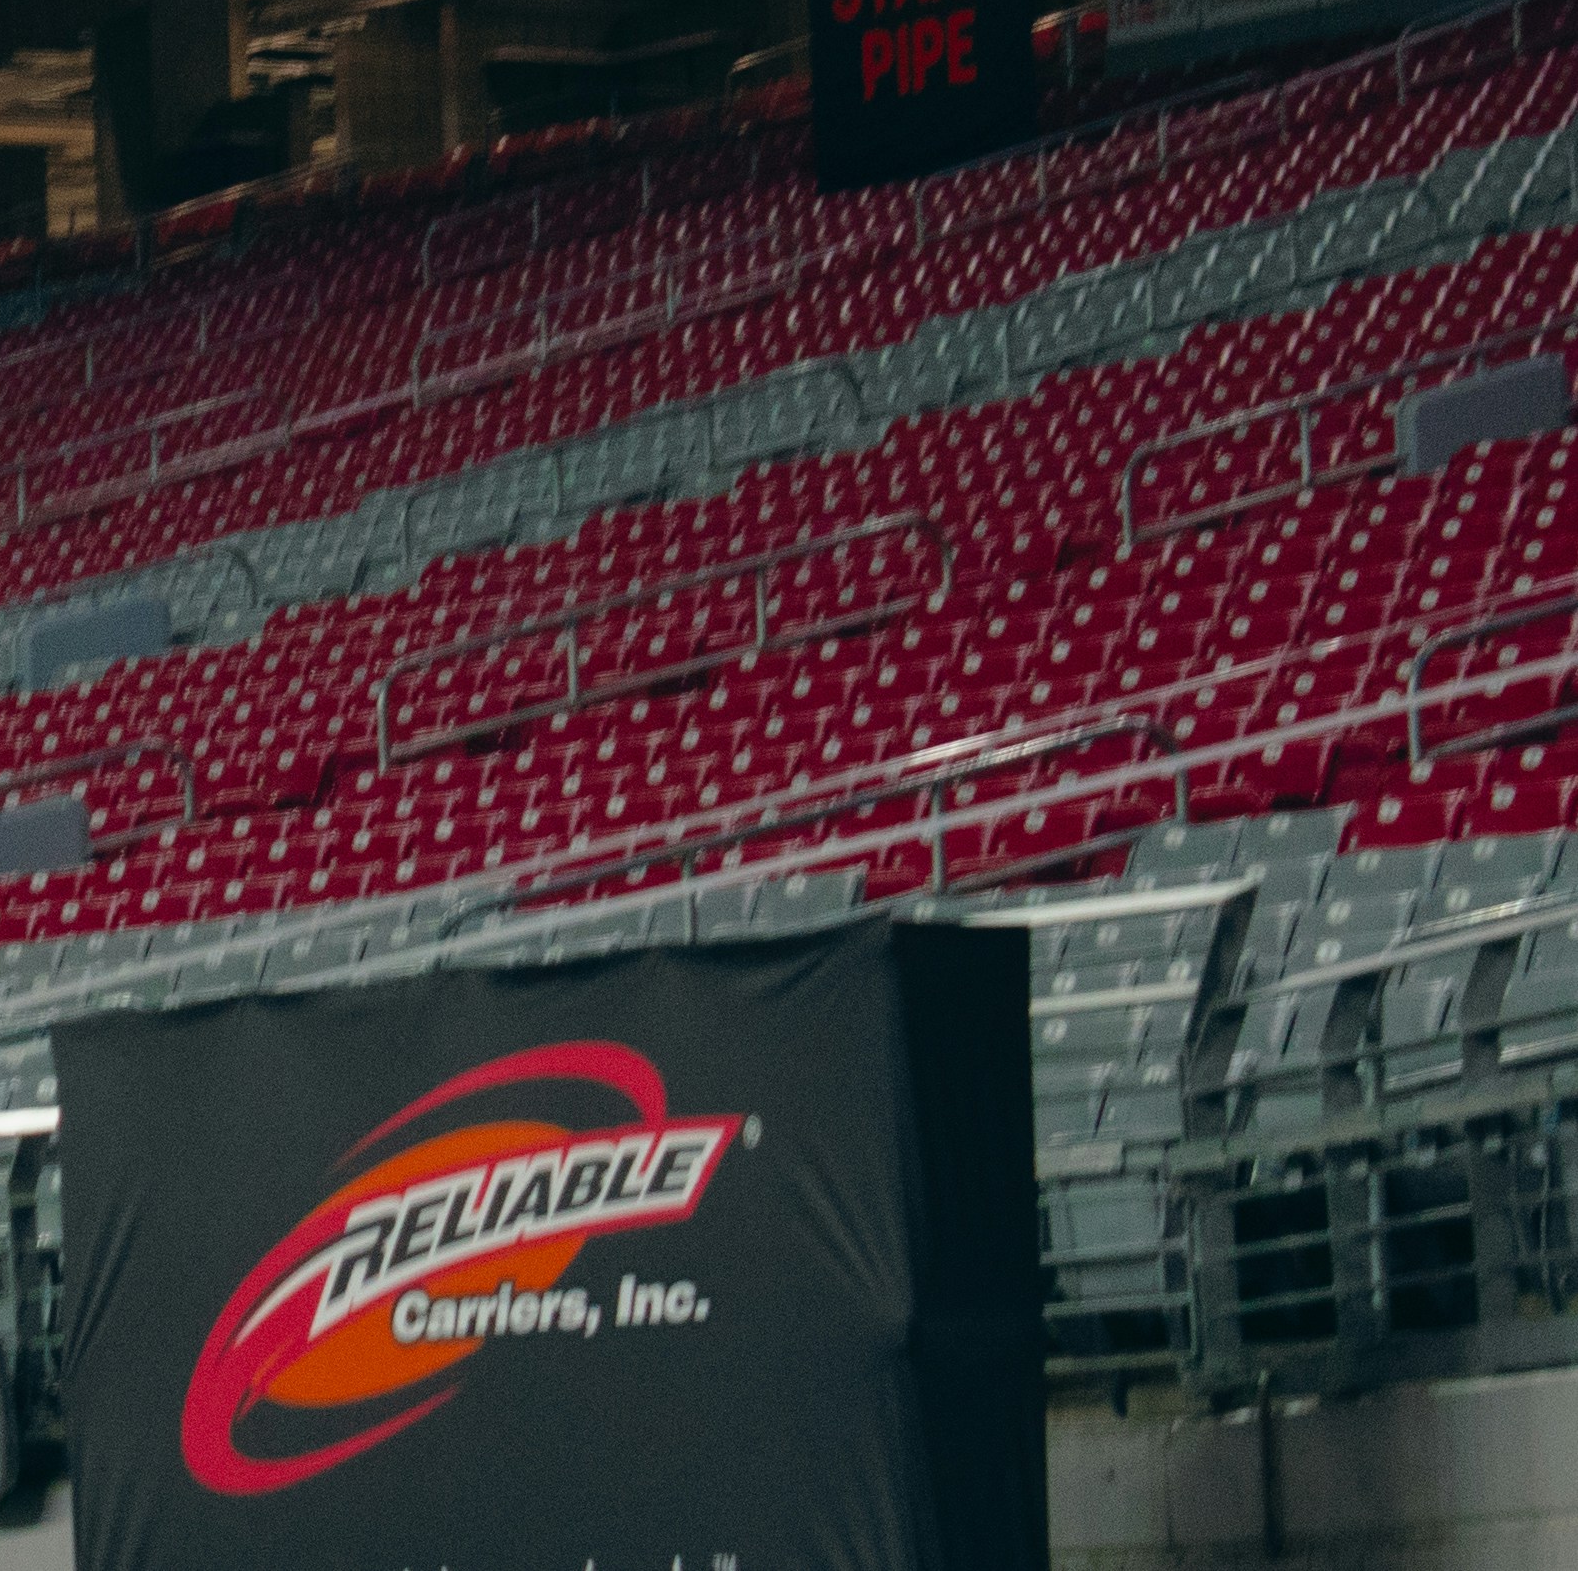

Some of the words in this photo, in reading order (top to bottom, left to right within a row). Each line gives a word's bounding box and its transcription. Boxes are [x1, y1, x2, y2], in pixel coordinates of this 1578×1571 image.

[860, 6, 978, 104] PIPE
[315, 1131, 721, 1315] RELIABLE
[391, 1279, 601, 1345] Carriers,
[614, 1272, 712, 1330] Inc.
